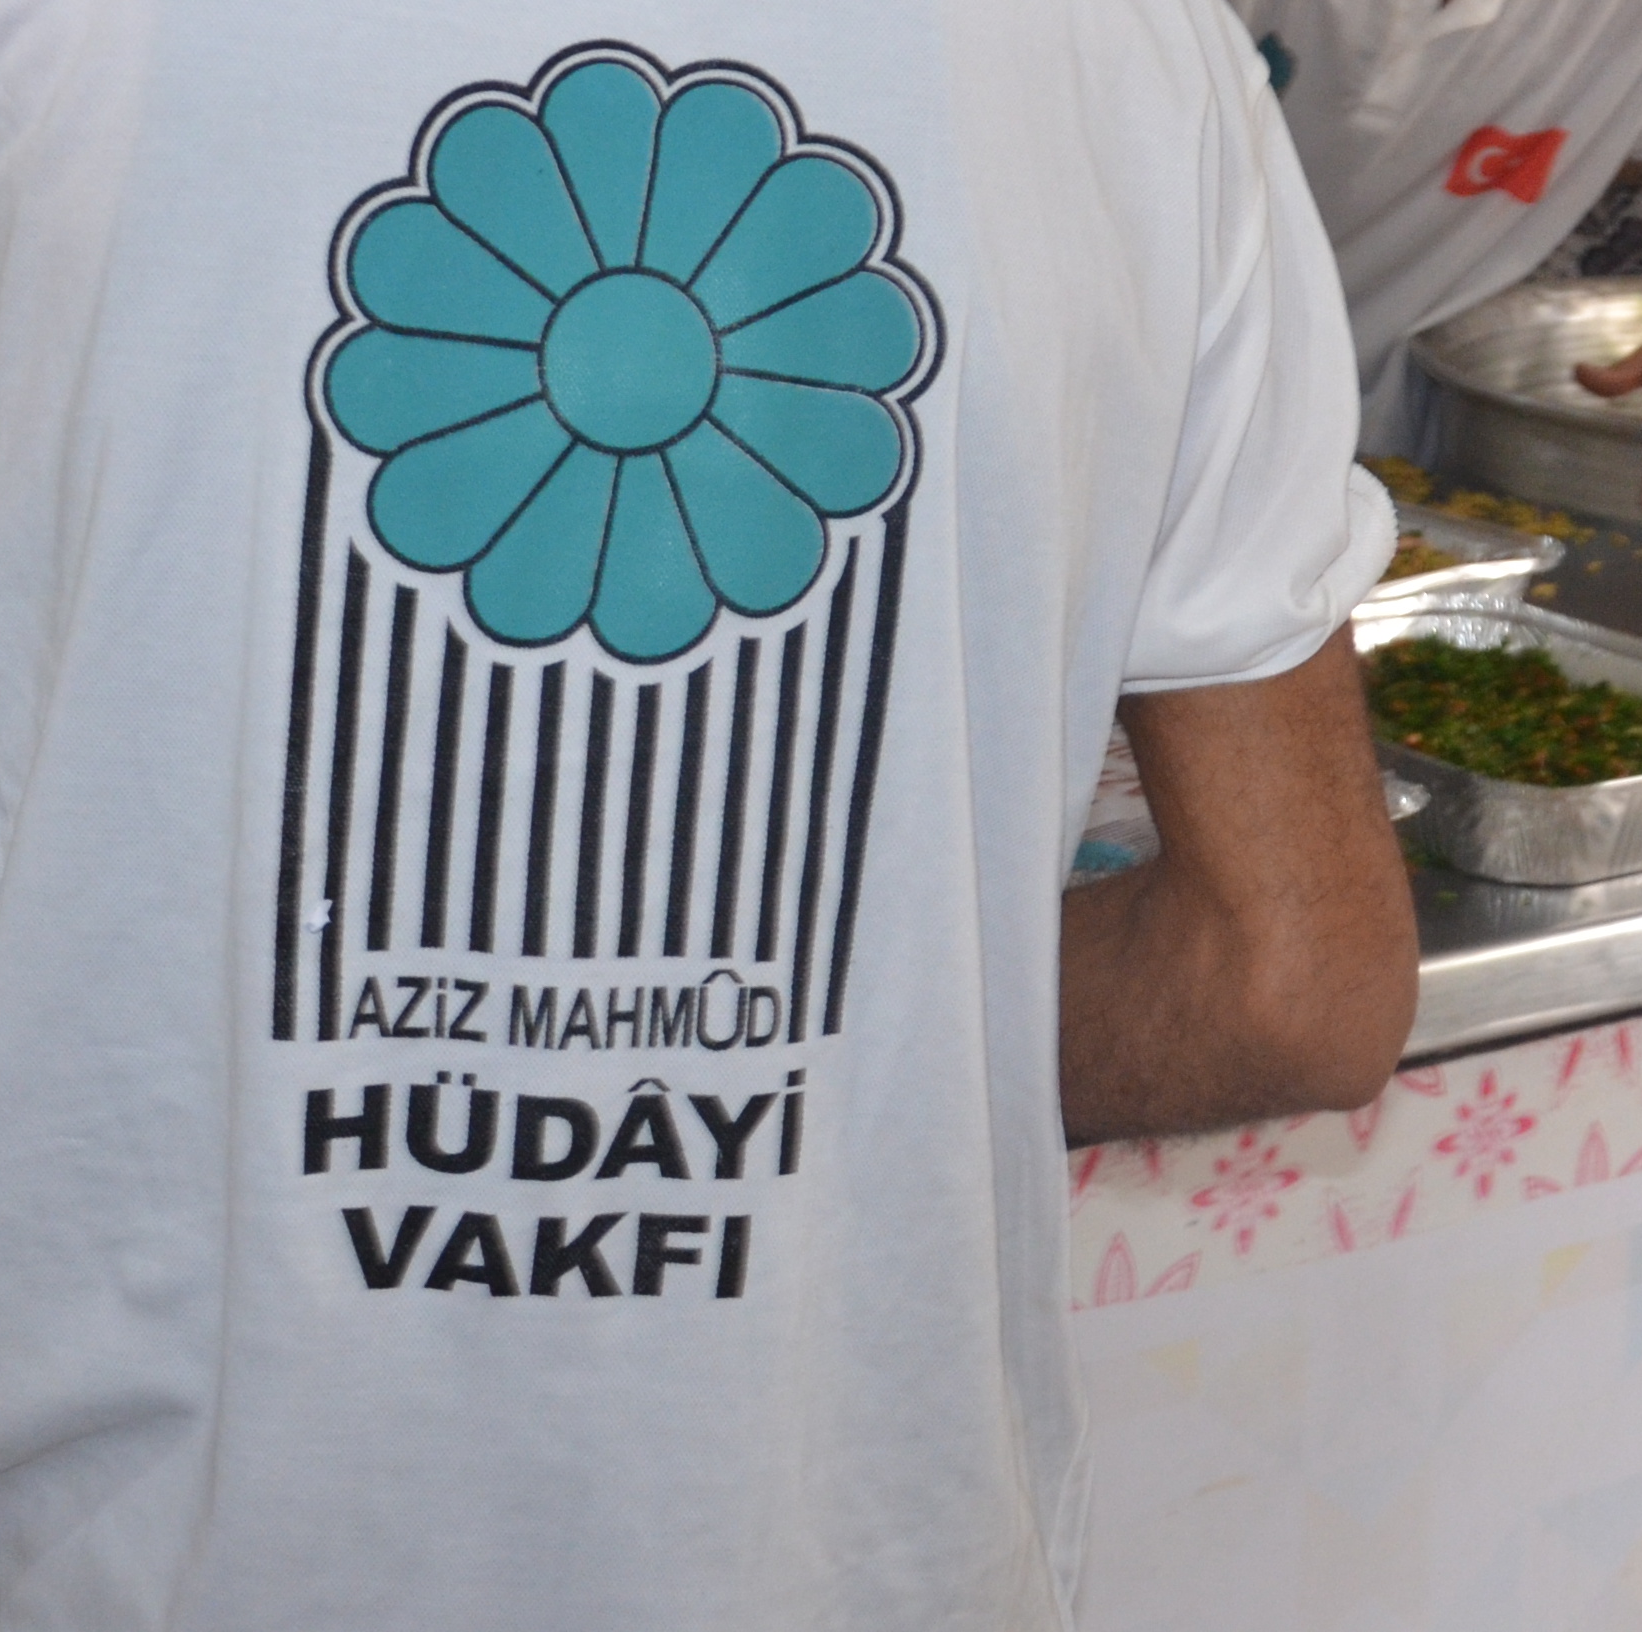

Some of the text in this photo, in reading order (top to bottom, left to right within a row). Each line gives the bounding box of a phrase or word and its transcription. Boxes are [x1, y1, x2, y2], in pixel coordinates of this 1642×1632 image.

[348, 968, 783, 1051] AZİZ MAHMÛD
[302, 1067, 807, 1181] HÜDÂYİ
[341, 1204, 752, 1299] VAKFI
